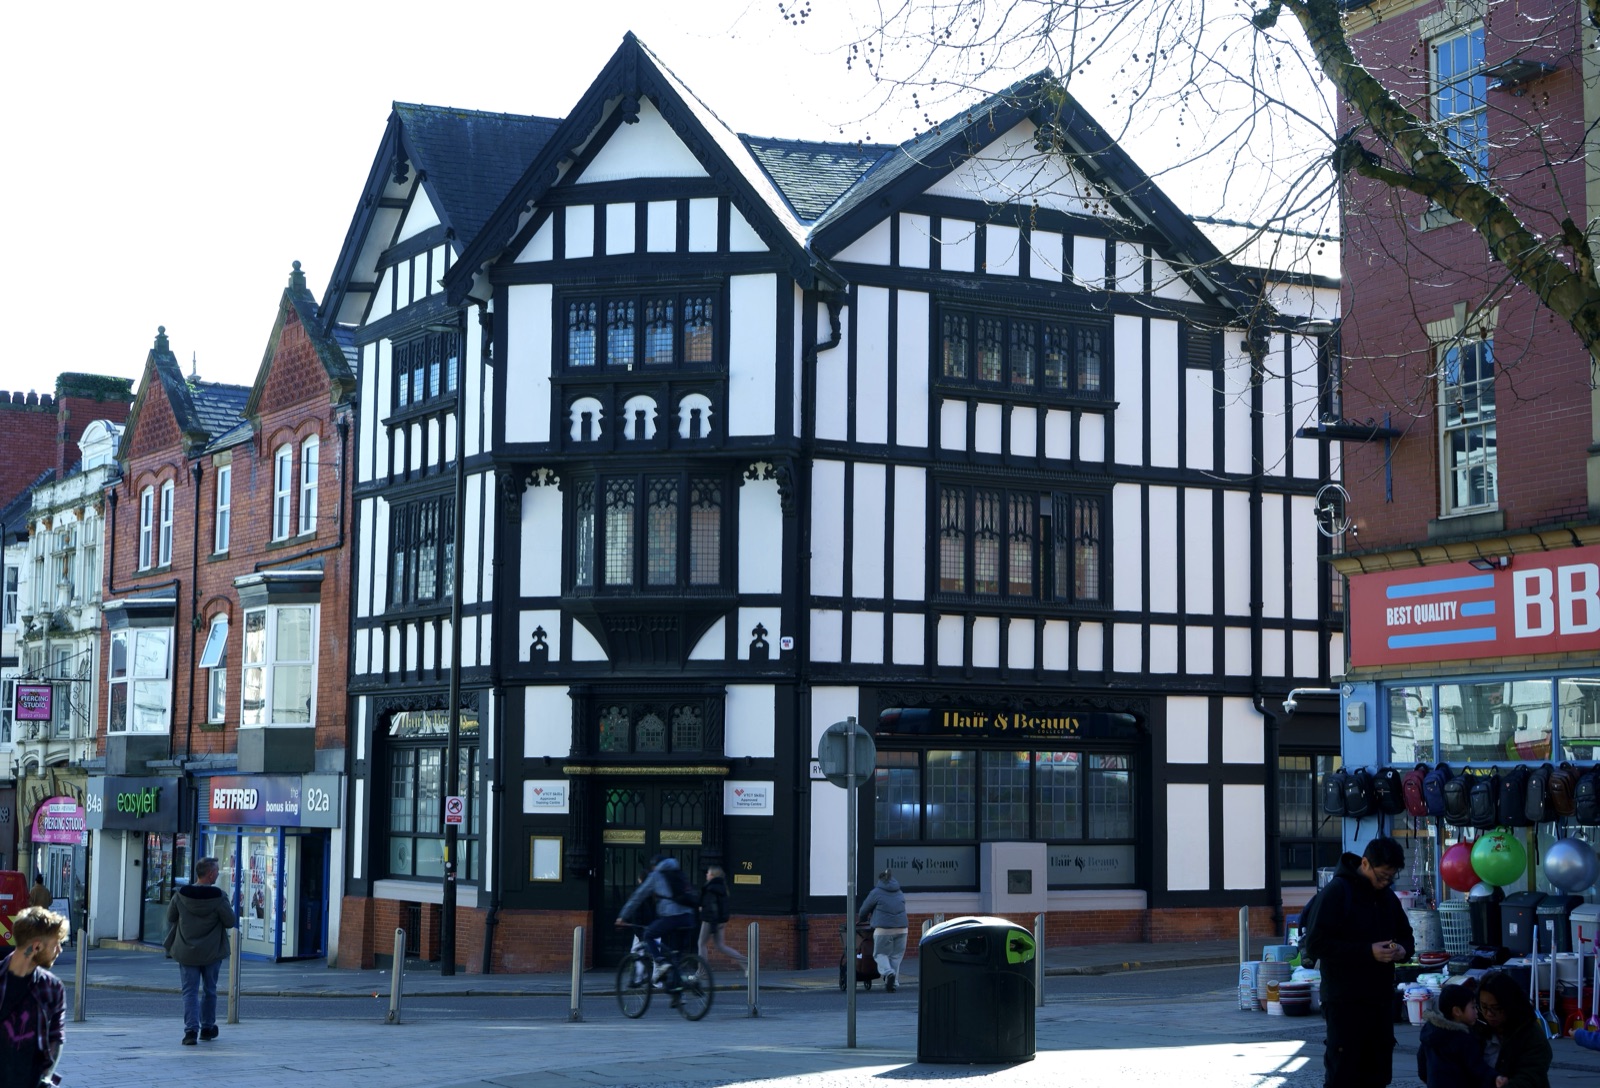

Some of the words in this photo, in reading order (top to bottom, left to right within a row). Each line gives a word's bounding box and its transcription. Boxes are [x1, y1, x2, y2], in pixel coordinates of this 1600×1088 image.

[1386, 606, 1412, 626] BEST
[1413, 601, 1458, 625] QUALITY
[20, 694, 49, 702] PIERCING
[943, 711, 989, 728] Hair
[994, 713, 1009, 731] &
[1013, 713, 1080, 734] Beauty
[212, 788, 258, 810] BETFRED
[290, 786, 299, 798] the
[307, 787, 330, 811] 82a
[86, 793, 102, 812] 84a
[117, 786, 158, 818] easylet
[265, 800, 284, 812] bonus
[284, 800, 299, 815] king
[44, 816, 65, 830] PIERCING
[65, 816, 84, 831] STUDIO
[742, 861, 753, 870] 78
[886, 858, 909, 869] Hair
[926, 858, 959, 871] Beauty
[1050, 856, 1072, 867] Hair
[1087, 857, 1119, 869] Beauty
